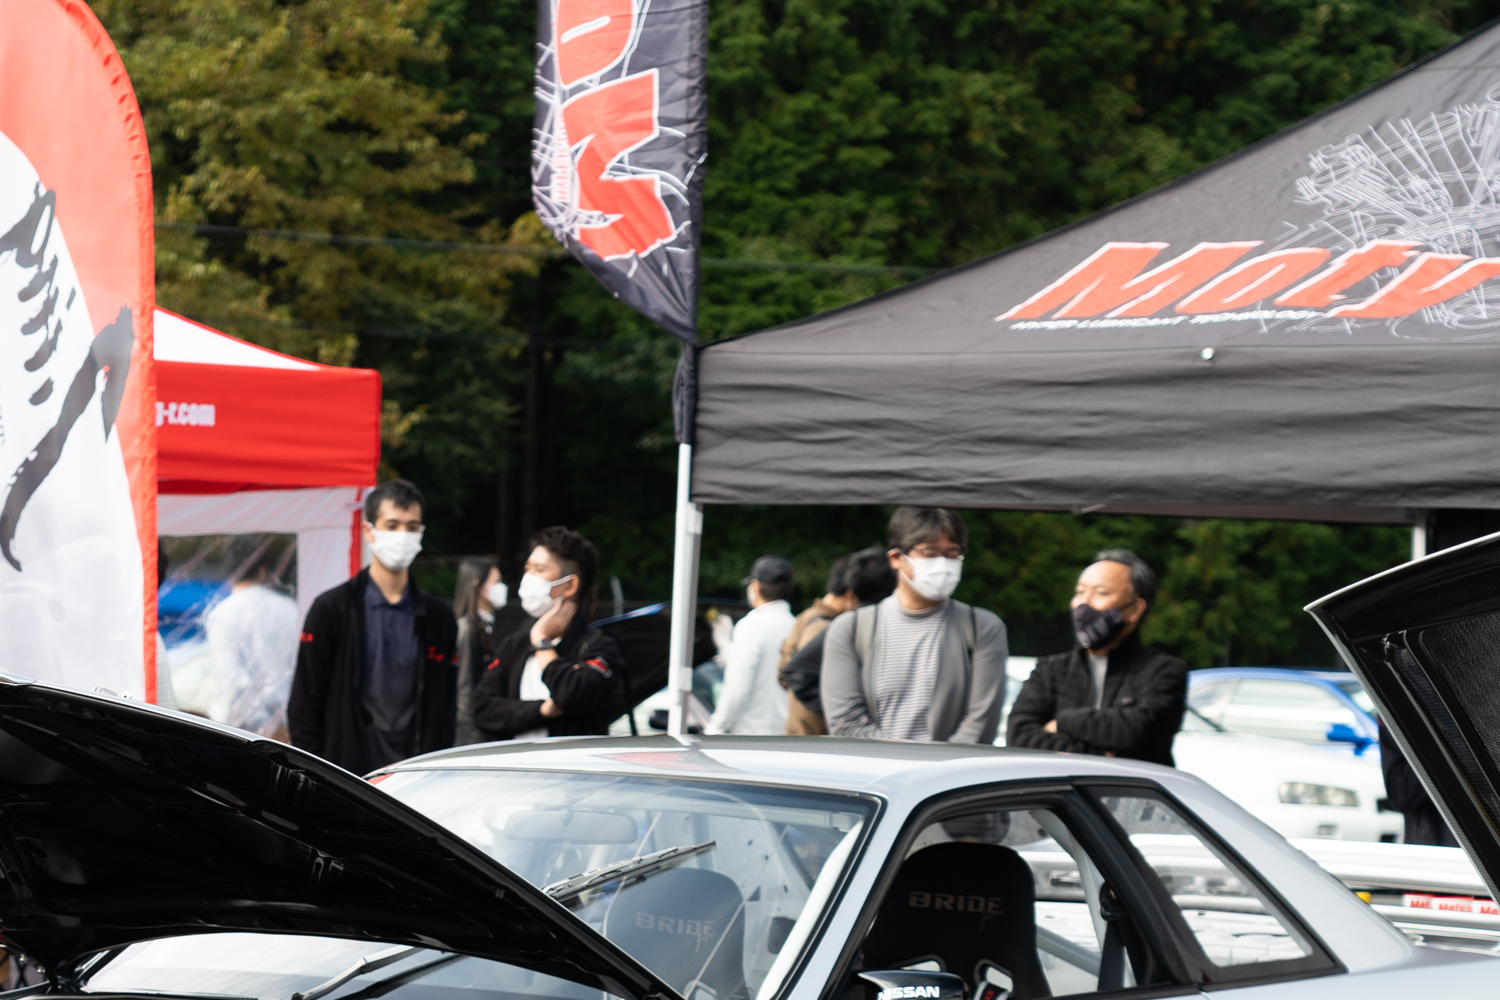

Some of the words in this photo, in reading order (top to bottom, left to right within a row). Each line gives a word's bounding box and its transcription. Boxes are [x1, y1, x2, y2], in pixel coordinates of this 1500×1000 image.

[994, 239, 1500, 319] Moty
[908, 891, 1004, 914] BRIDE
[635, 911, 717, 936] BRIDE
